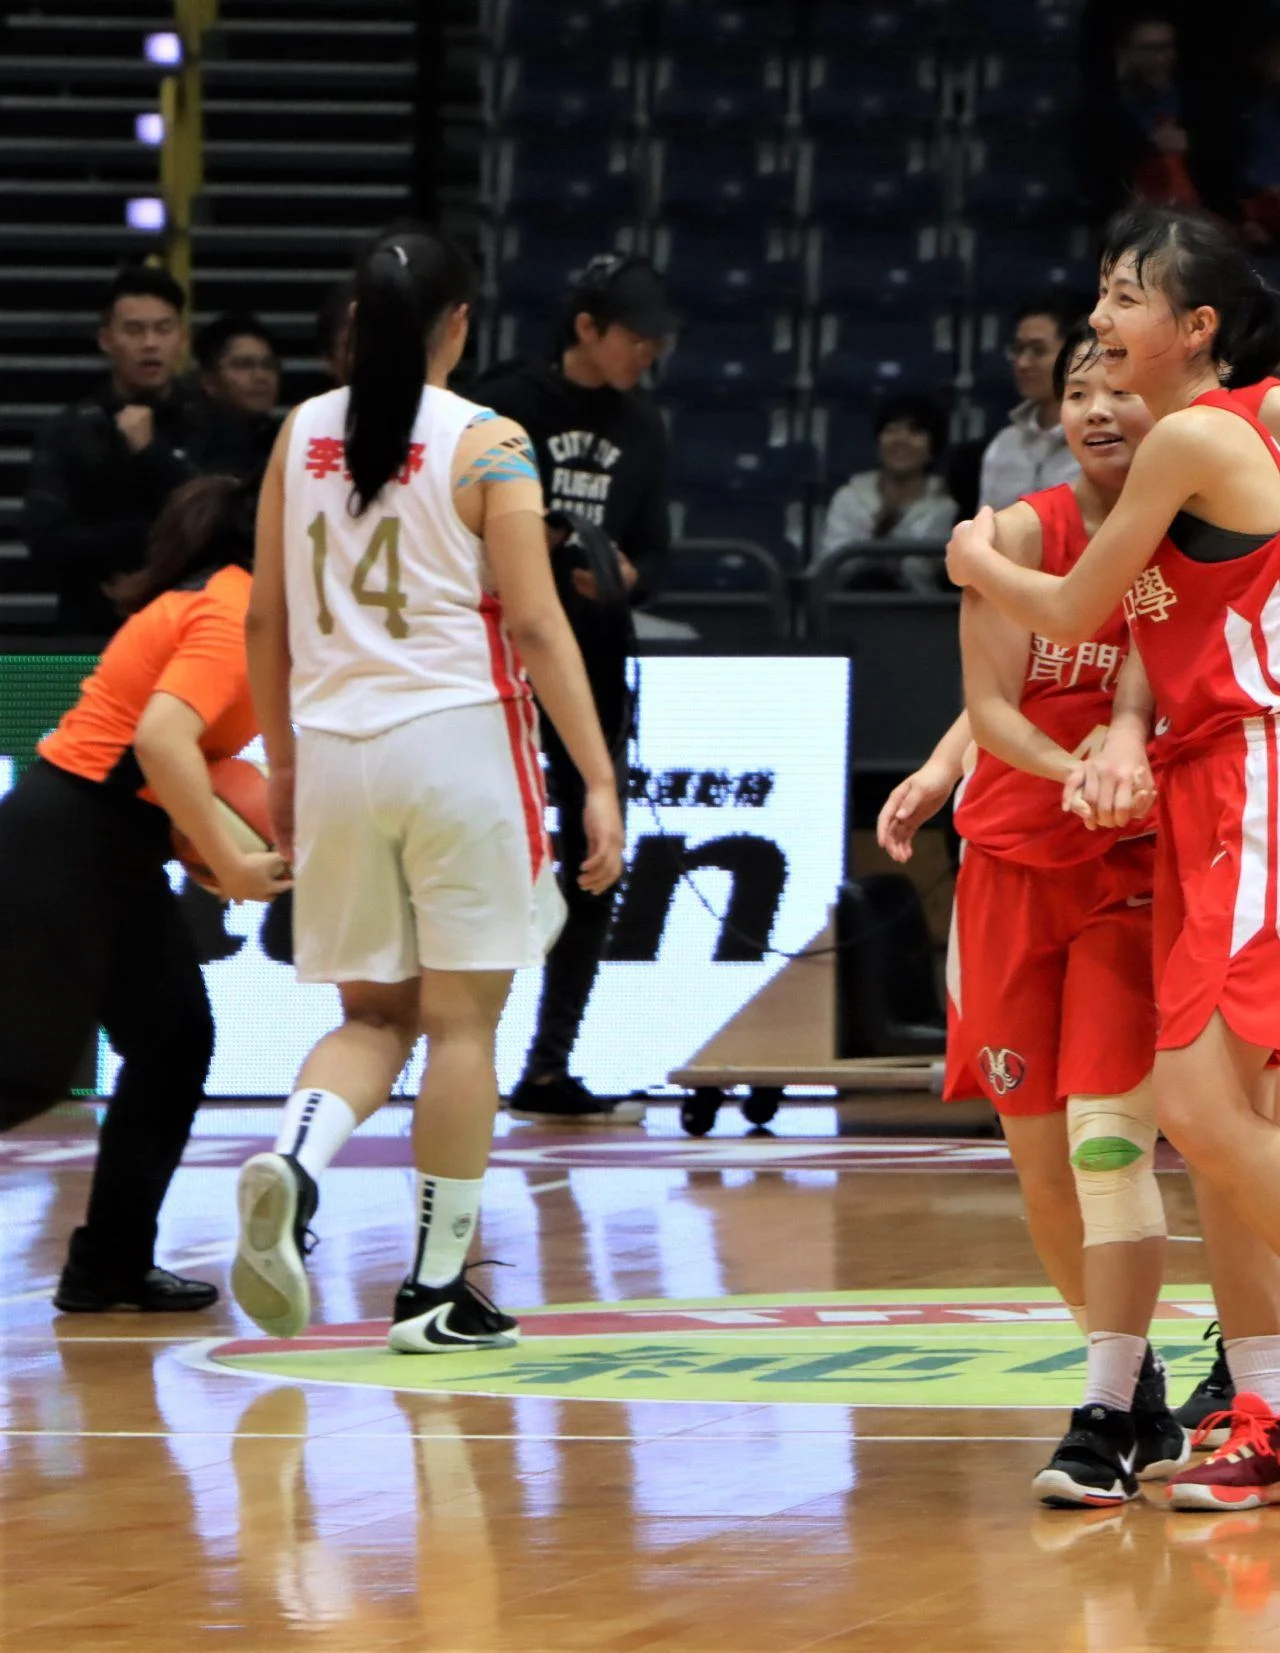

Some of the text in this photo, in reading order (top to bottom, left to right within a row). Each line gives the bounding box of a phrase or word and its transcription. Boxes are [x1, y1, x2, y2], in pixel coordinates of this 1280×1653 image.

[552, 467, 612, 501] FLIGHT
[307, 510, 409, 640] 14
[1027, 634, 1127, 692] 普門
